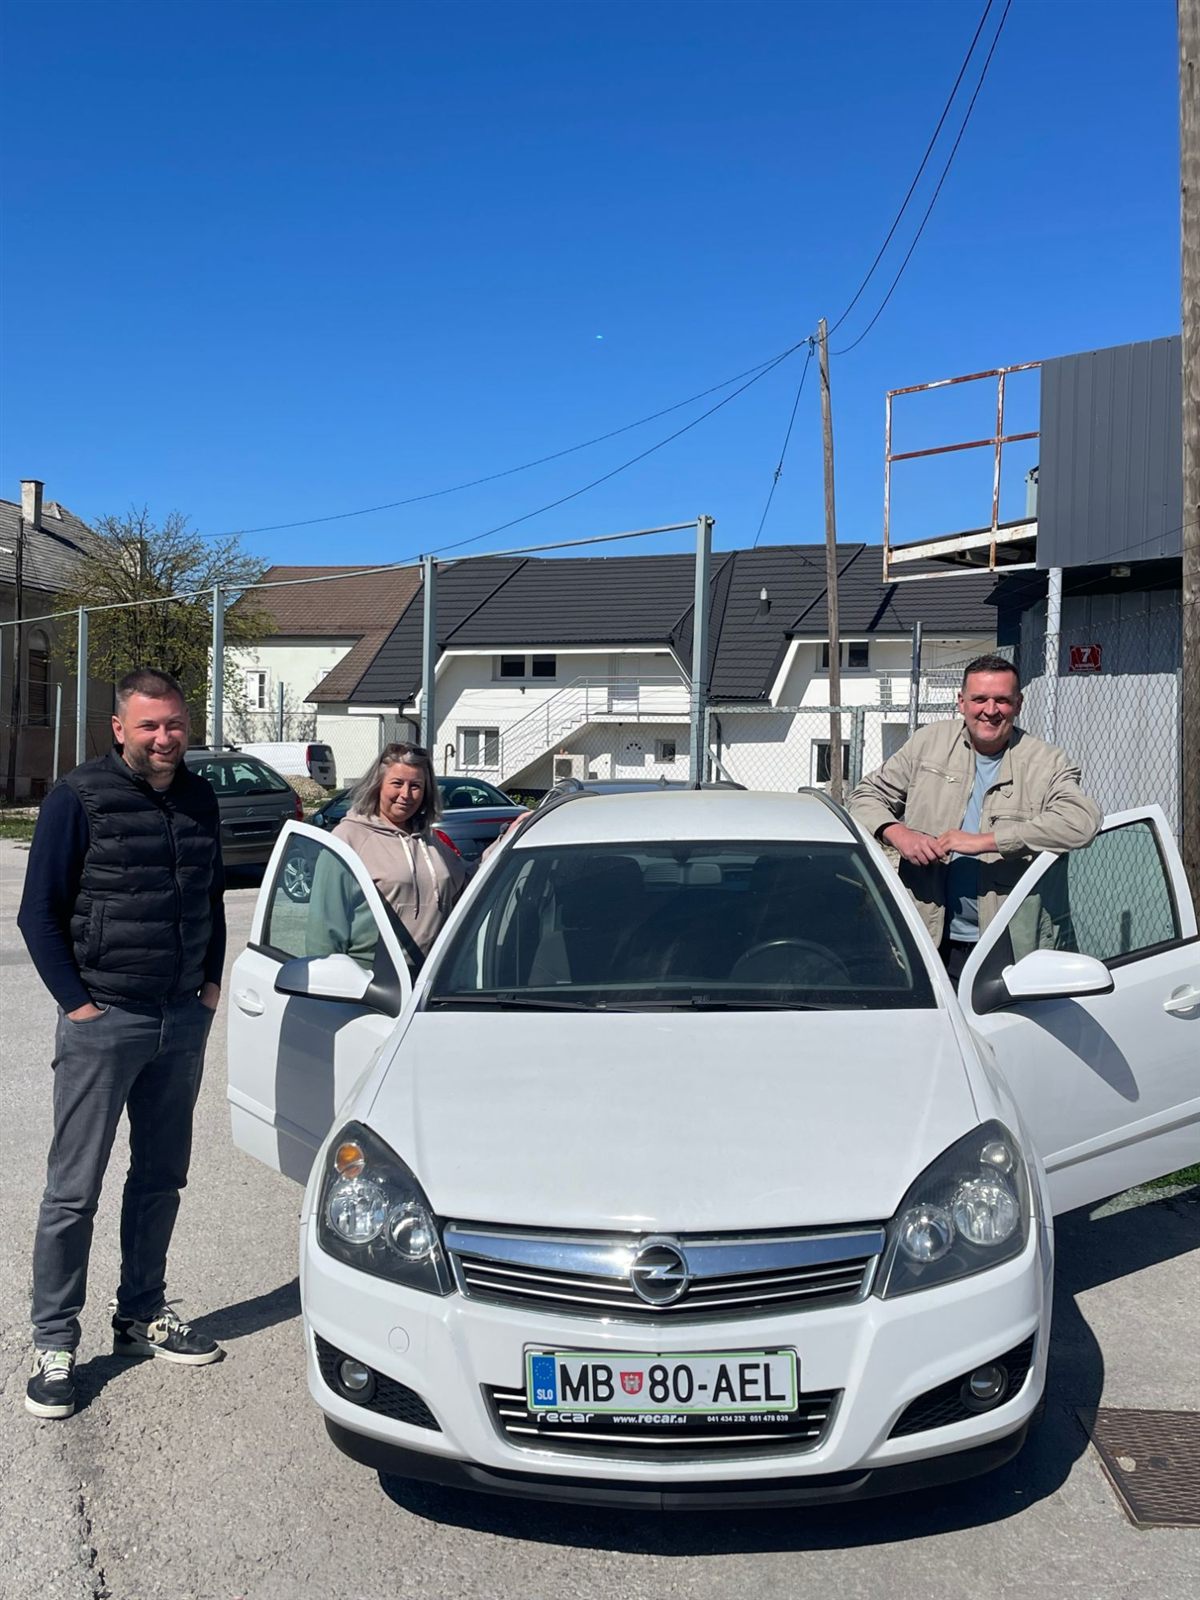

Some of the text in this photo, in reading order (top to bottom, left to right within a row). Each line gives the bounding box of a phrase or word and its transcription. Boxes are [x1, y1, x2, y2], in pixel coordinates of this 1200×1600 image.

[1081, 648, 1091, 662] 7
[560, 1363, 786, 1403] MB 80-AEL
[537, 1389, 553, 1400] SLO
[536, 1412, 594, 1423] recar
[612, 1413, 687, 1424] www.recar.si
